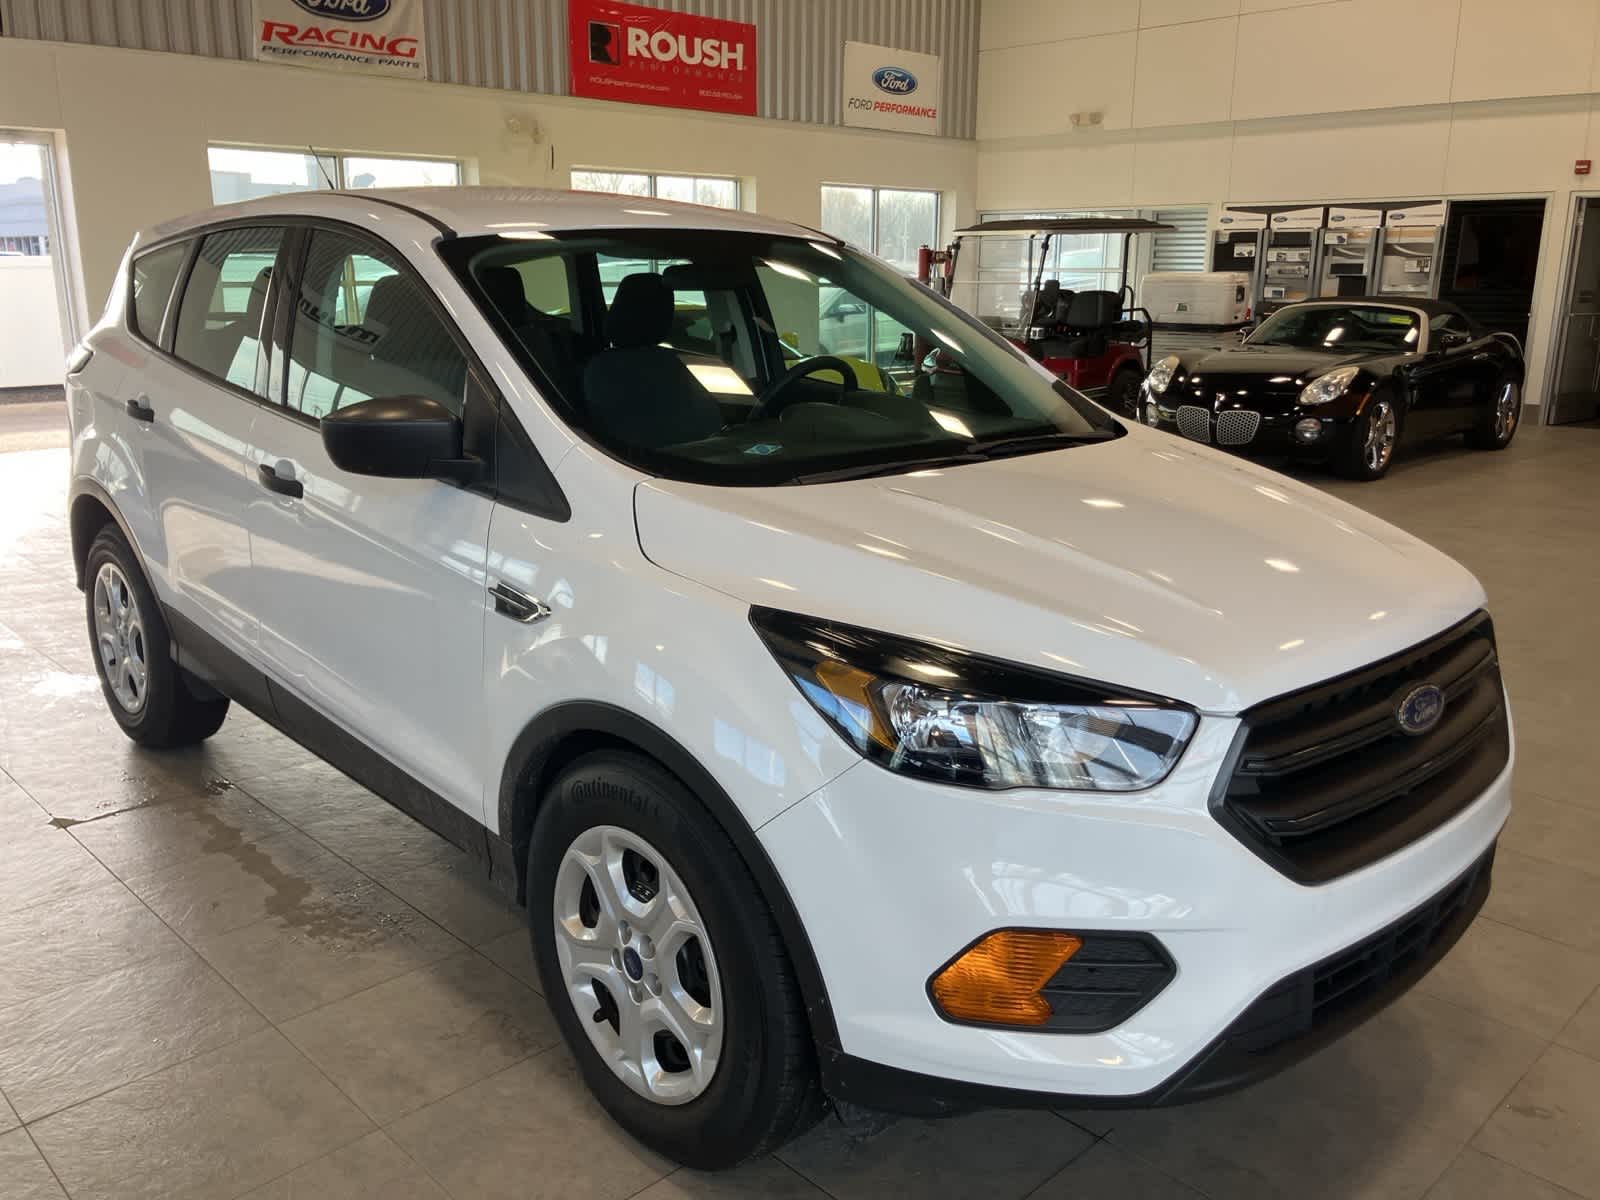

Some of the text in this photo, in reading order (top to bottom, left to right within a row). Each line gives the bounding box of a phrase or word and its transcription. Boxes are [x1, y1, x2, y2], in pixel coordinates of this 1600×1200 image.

[261, 21, 418, 57] RACING
[627, 27, 744, 71] ROUSH
[262, 45, 420, 69] PERFORMANCE PARTS
[881, 70, 910, 91] Ford
[848, 98, 937, 118] FORD PERFORMANCE
